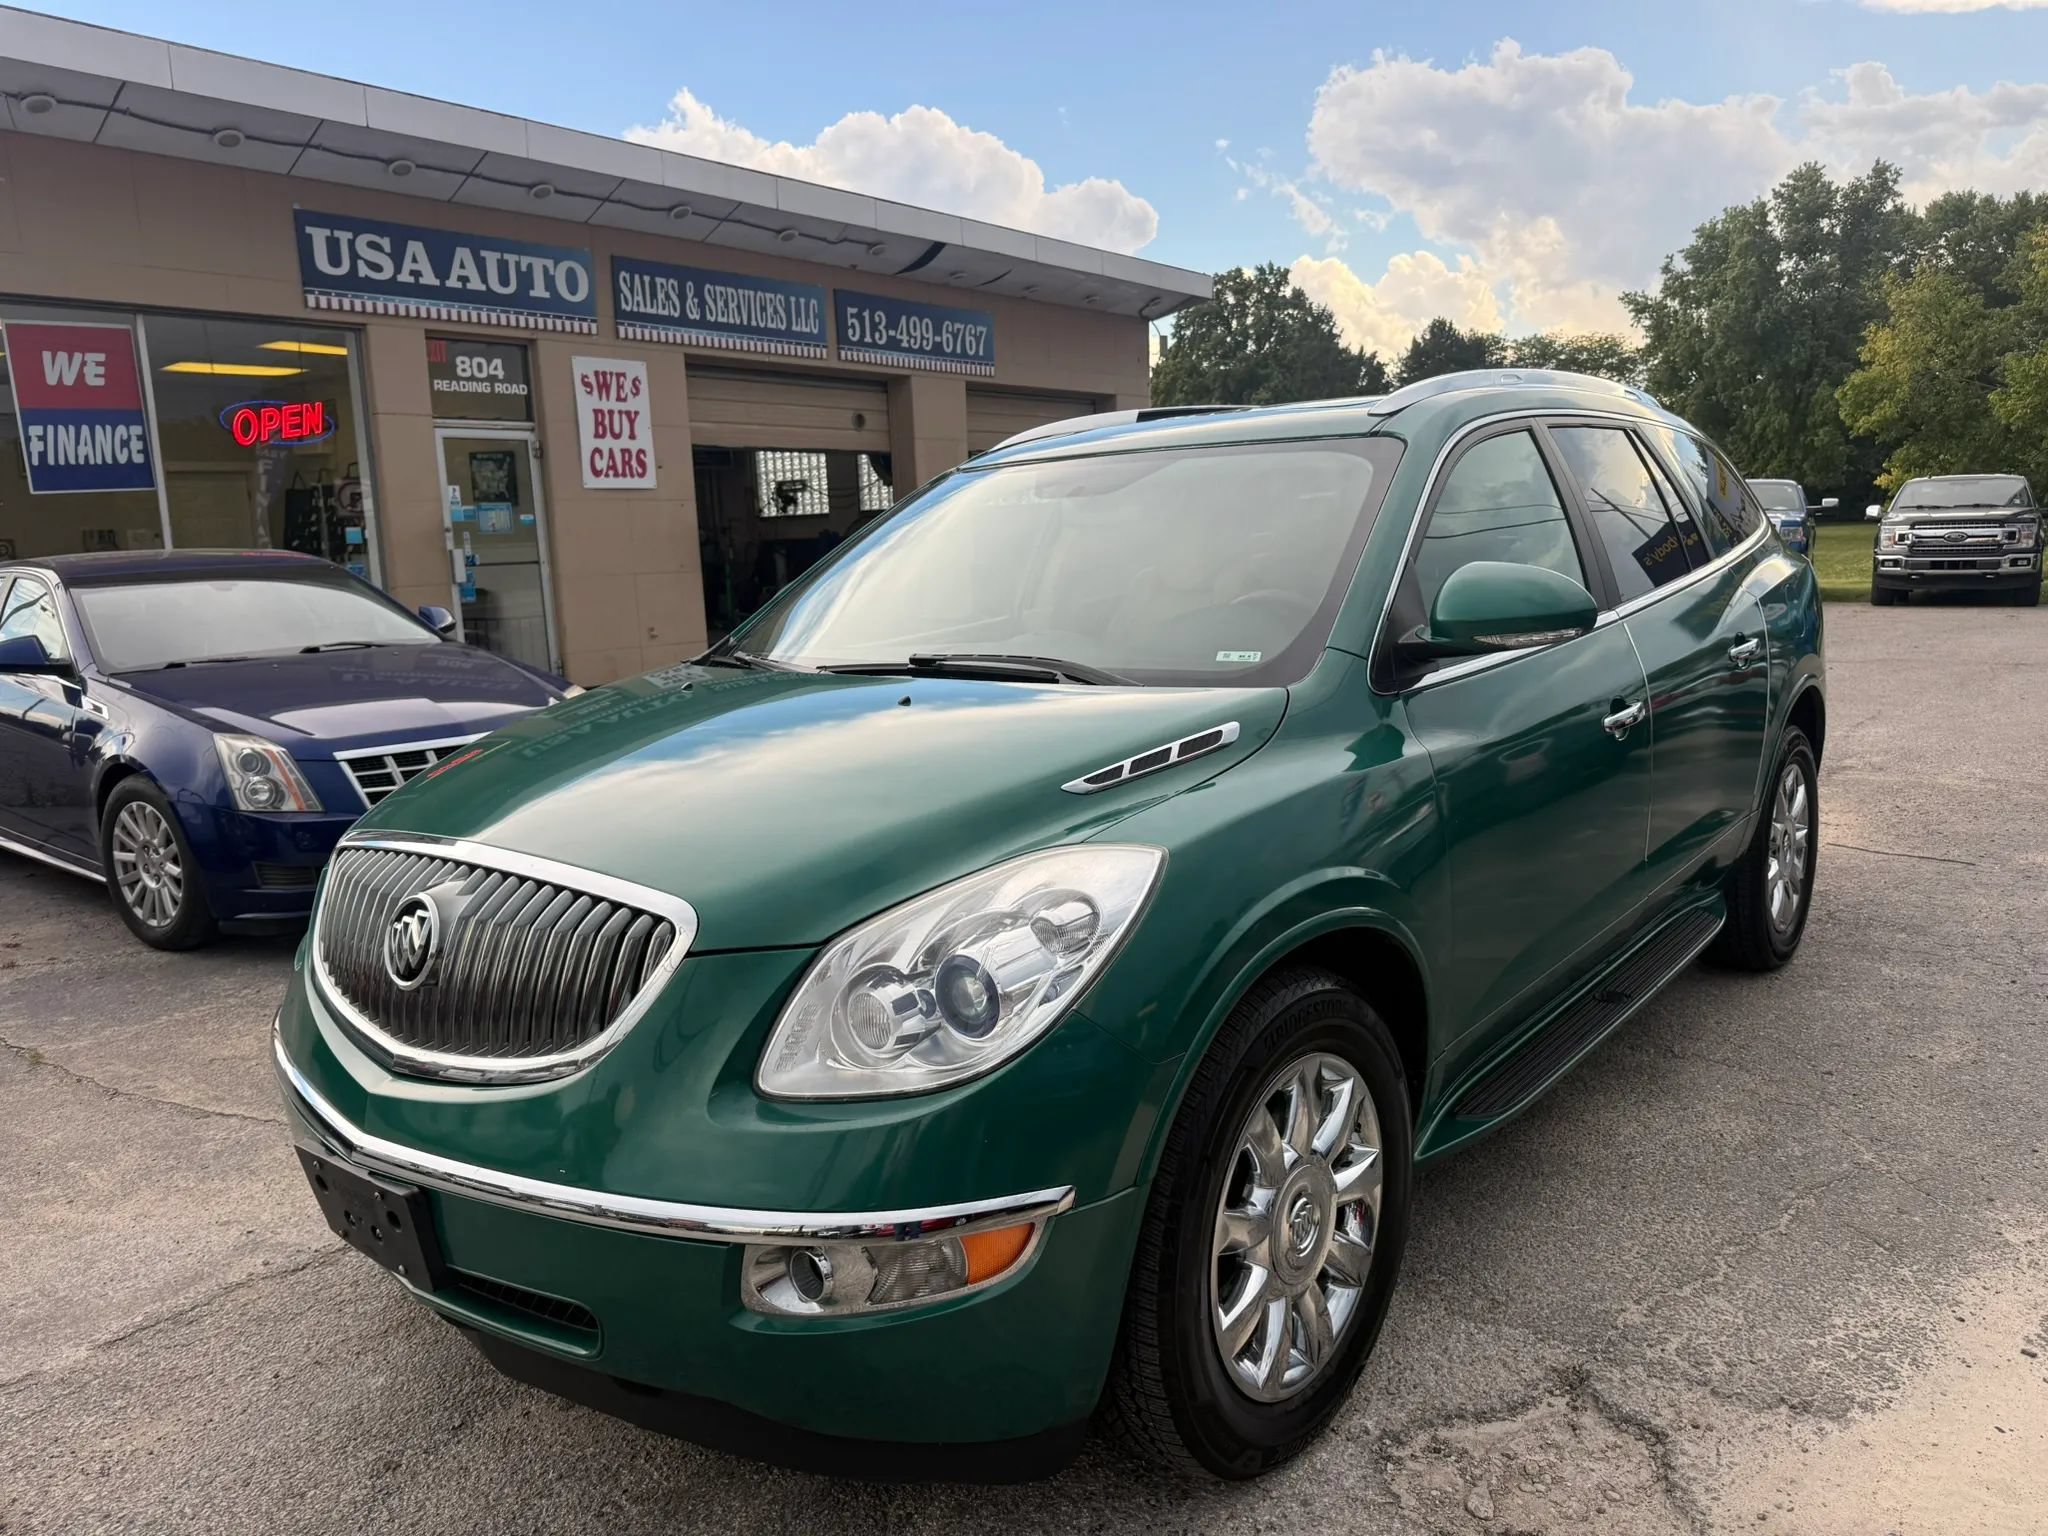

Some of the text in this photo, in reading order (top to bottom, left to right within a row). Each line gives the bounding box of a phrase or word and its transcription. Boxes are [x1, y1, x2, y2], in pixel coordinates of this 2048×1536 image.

[305, 225, 590, 302] USA AUTO
[619, 270, 820, 335] SALES & SERVICES LLC
[846, 306, 988, 357] 513-499-6767
[41, 350, 106, 387] WE
[433, 379, 528, 395] READING ROAD
[456, 355, 505, 380] 804
[232, 401, 323, 447] OPEN
[592, 408, 640, 441] BUY
[28, 423, 145, 467] FINANCE
[590, 447, 648, 479] CARS
